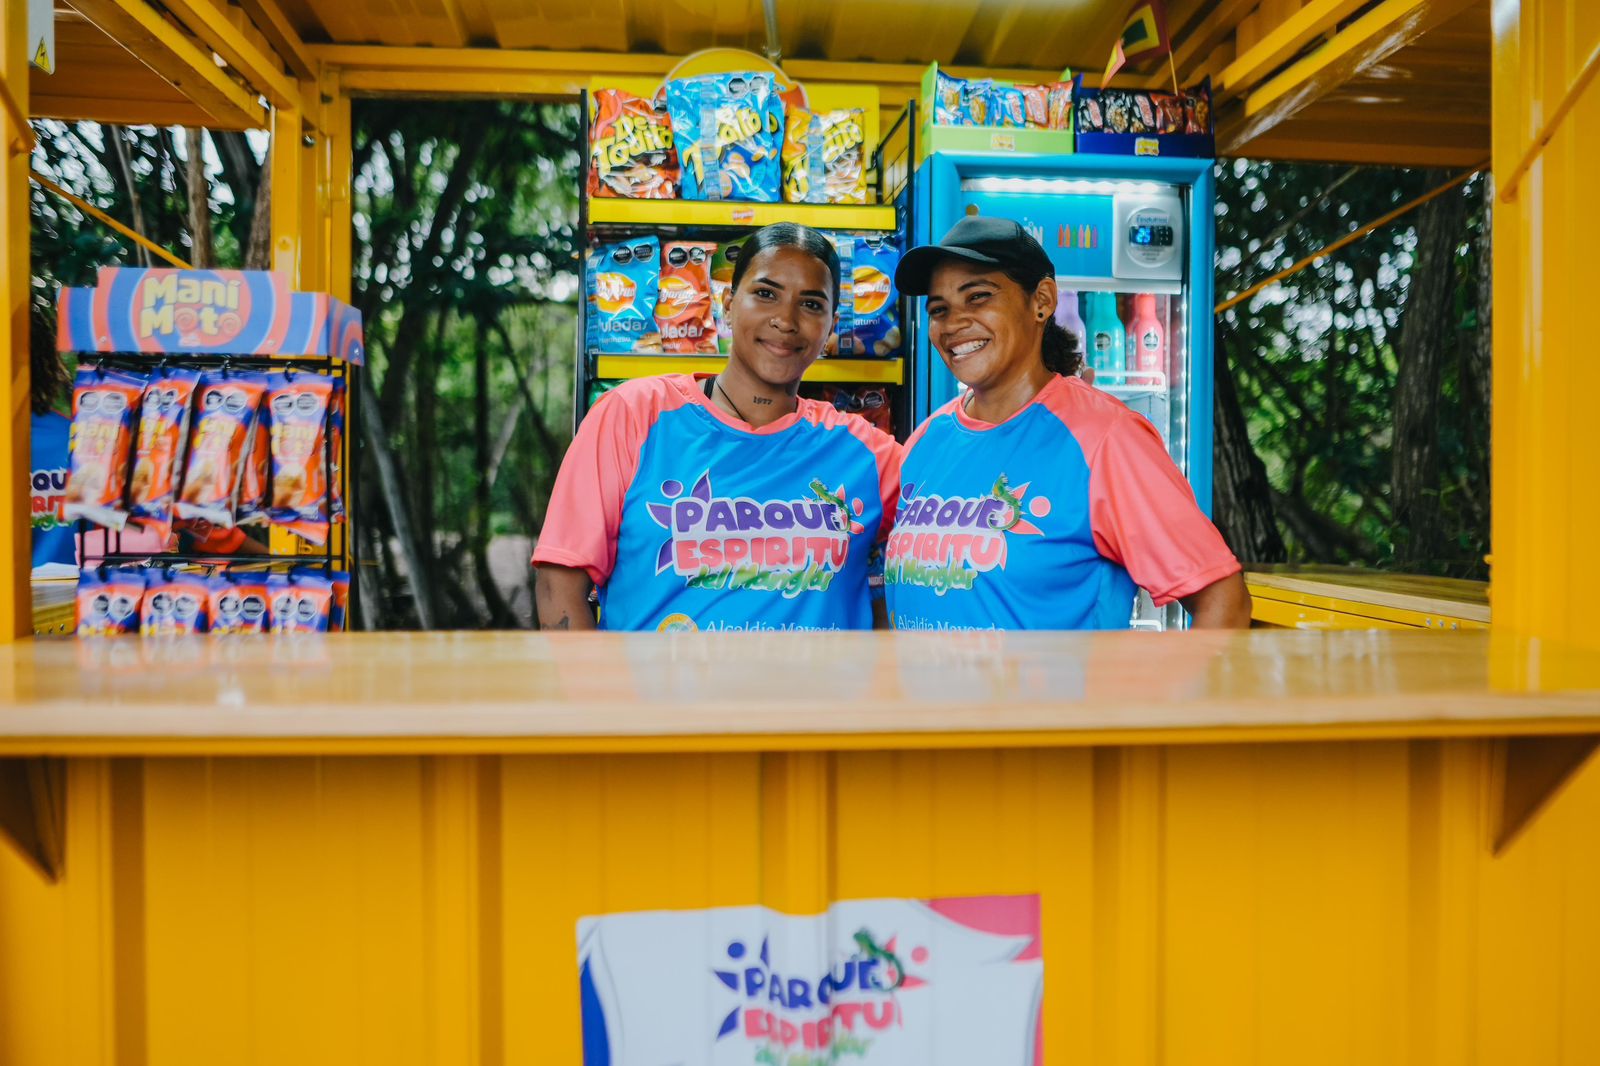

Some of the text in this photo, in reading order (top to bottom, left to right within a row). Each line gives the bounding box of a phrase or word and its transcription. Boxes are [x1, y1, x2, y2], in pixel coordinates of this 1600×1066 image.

[140, 304, 243, 339] Moto
[675, 500, 842, 533] PARQUE
[675, 536, 849, 571] ESPIRITU
[887, 531, 1001, 566] SPIRITU
[730, 561, 835, 598] Manglar
[744, 960, 881, 1007] PARQUE
